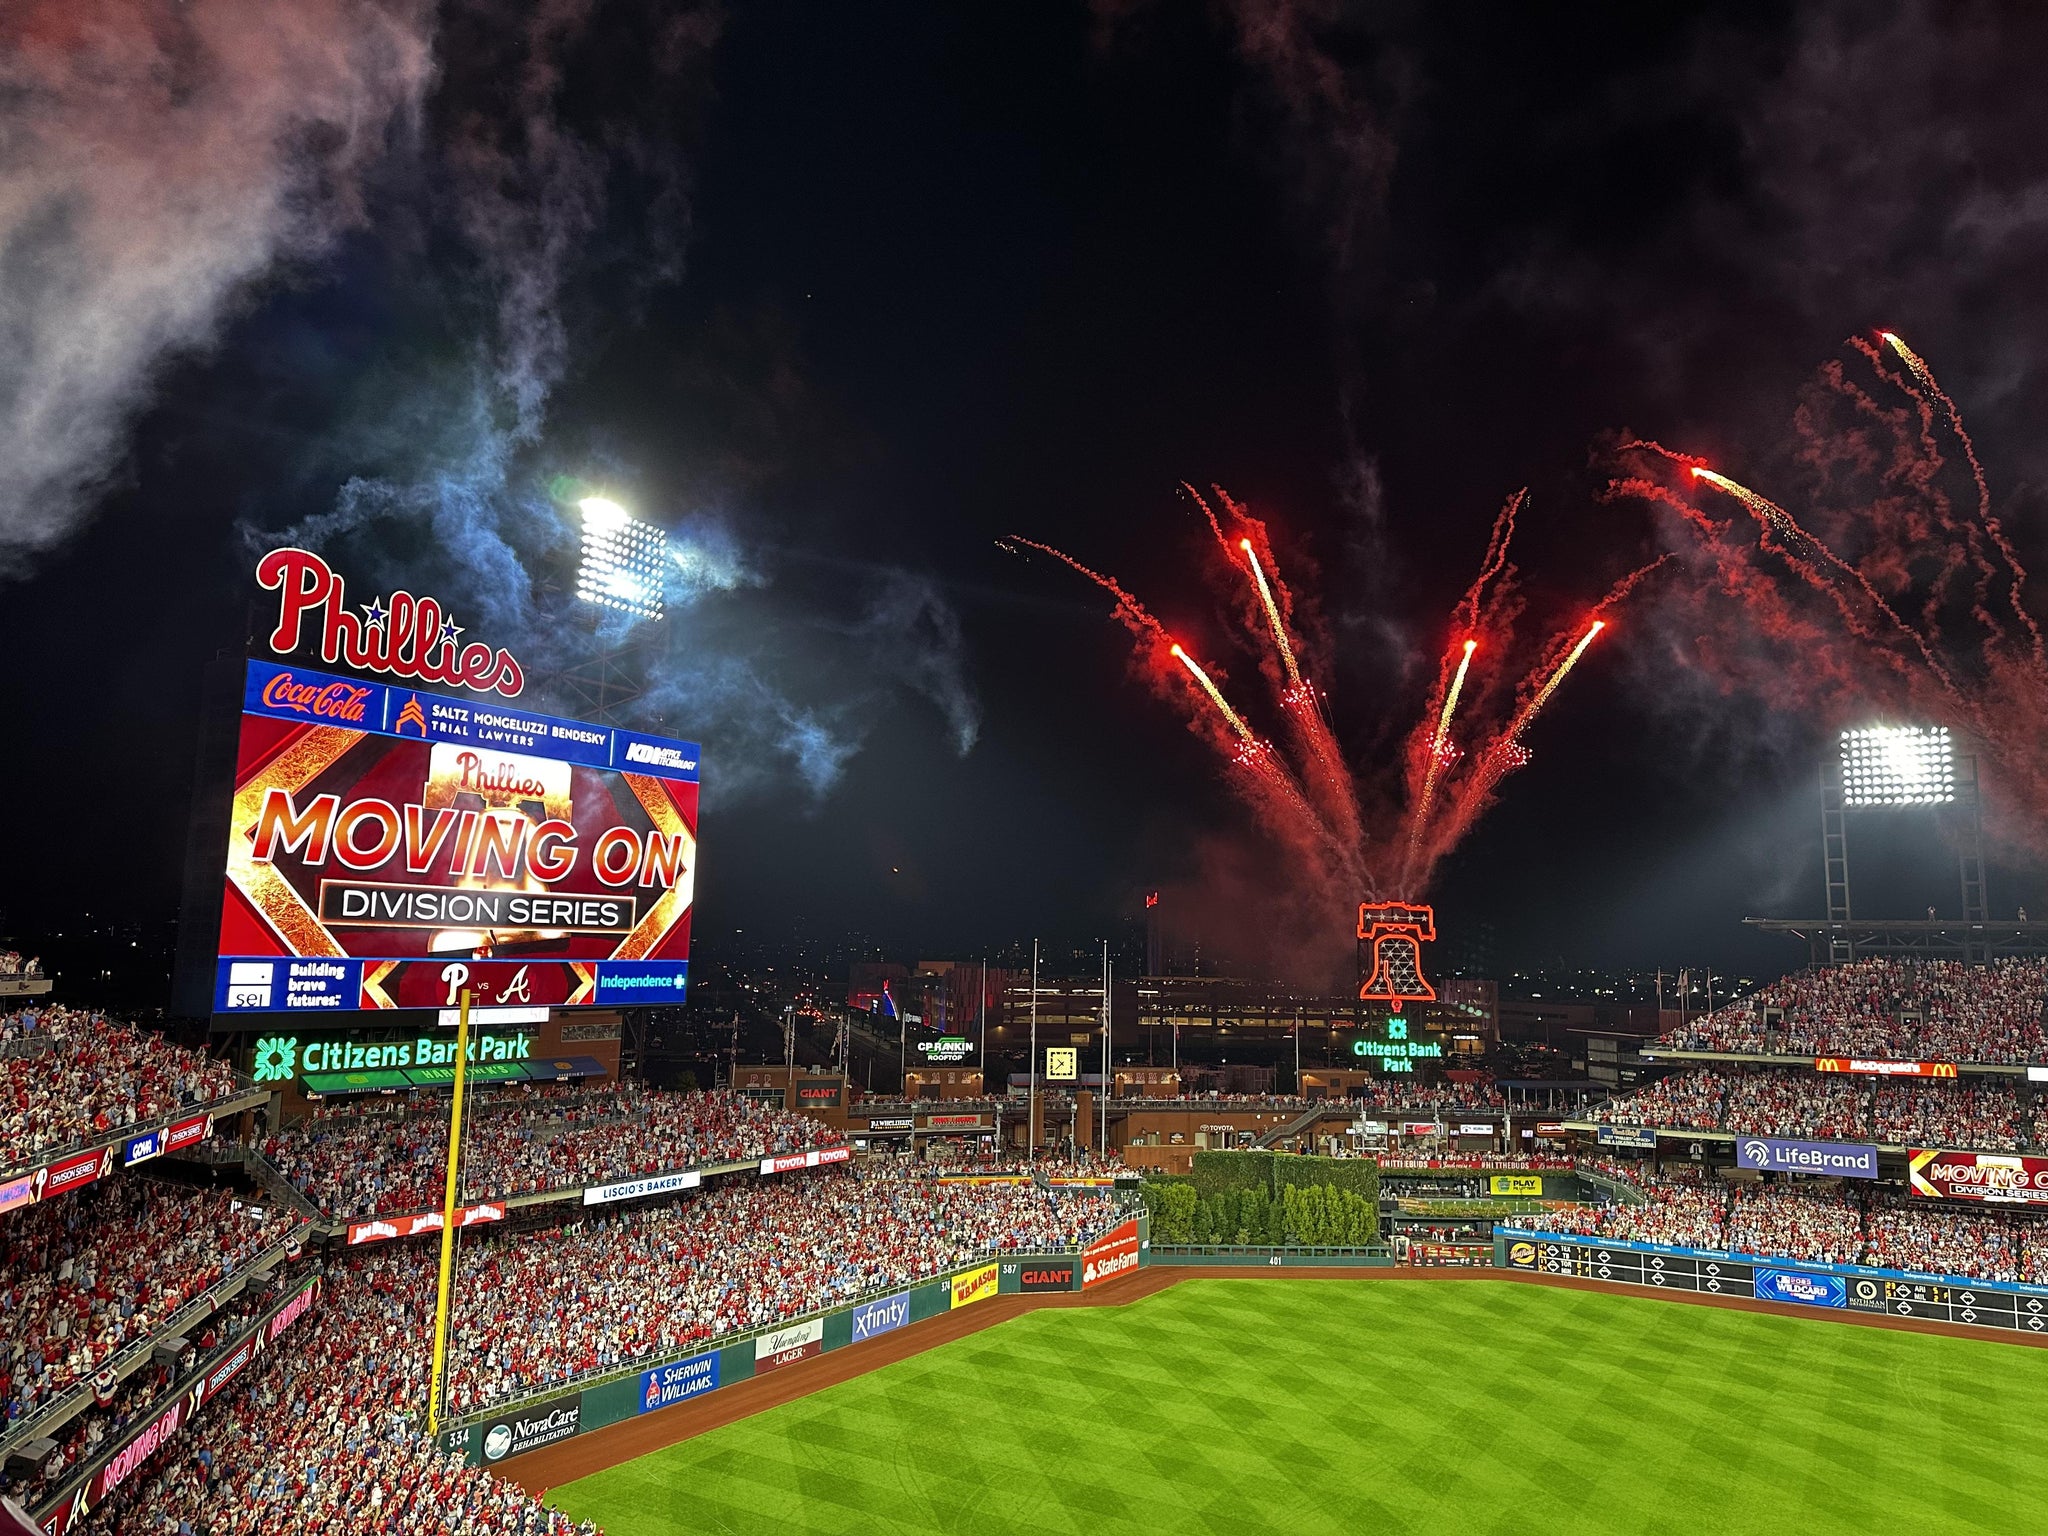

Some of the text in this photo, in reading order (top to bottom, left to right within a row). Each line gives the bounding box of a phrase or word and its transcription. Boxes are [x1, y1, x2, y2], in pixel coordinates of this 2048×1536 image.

[255, 547, 525, 698] Phillies
[262, 672, 373, 722] Coca-Cola
[431, 704, 606, 746] SALTZ MONGELUZZI BENDESKY
[431, 720, 534, 747] TRIAL LAWYERS
[456, 751, 546, 797] Phillies
[252, 788, 685, 888] MOVING ON
[341, 889, 619, 927] DIVISION SERIES
[289, 962, 346, 980] Building
[288, 978, 327, 991] brave
[441, 962, 469, 1006] P
[496, 964, 531, 1004] A
[601, 974, 672, 991] Independence
[302, 1033, 530, 1072] Citizens Bank Park
[1354, 1041, 1442, 1057] Citizens Bank
[1383, 1057, 1414, 1072] Park
[1850, 1060, 1921, 1074] McDonald's
[800, 1088, 838, 1098] GIANT
[775, 1149, 849, 1169] TOYOTA TOYOTA
[1380, 1160, 1428, 1169] #HITTHEBUDS
[1481, 1161, 1530, 1170] #HITTHEBUDS
[1775, 1147, 1870, 1169] LifeBrand
[52, 1162, 95, 1185] DIVISION SERIES
[1930, 1163, 2048, 1190] MOVING O
[603, 1176, 684, 1199] LISCIO'S BAKERY
[1955, 1185, 2048, 1200] DIVISION SERIES
[1598, 1239, 1627, 1247] Independence
[1269, 1256, 1282, 1266] 401
[1693, 1250, 1724, 1258] Independence
[1002, 1264, 1017, 1275] 387
[1795, 1261, 1828, 1269] Independence
[1022, 1270, 1073, 1284] GIANT
[1914, 1285, 1926, 1293] ARI
[1914, 1293, 1926, 1301] MIL
[1849, 1297, 1885, 1306] ROTHMAN
[855, 1300, 906, 1337] xfinity
[768, 1326, 811, 1354] Yuengling
[230, 1351, 249, 1372] SERIES
[662, 1358, 712, 1386] SHERWIN
[512, 1406, 579, 1441] NovaCare
[449, 1428, 470, 1448] 334
[512, 1425, 576, 1453] REHABILITATION
[102, 1402, 180, 1499] MOVING ON
